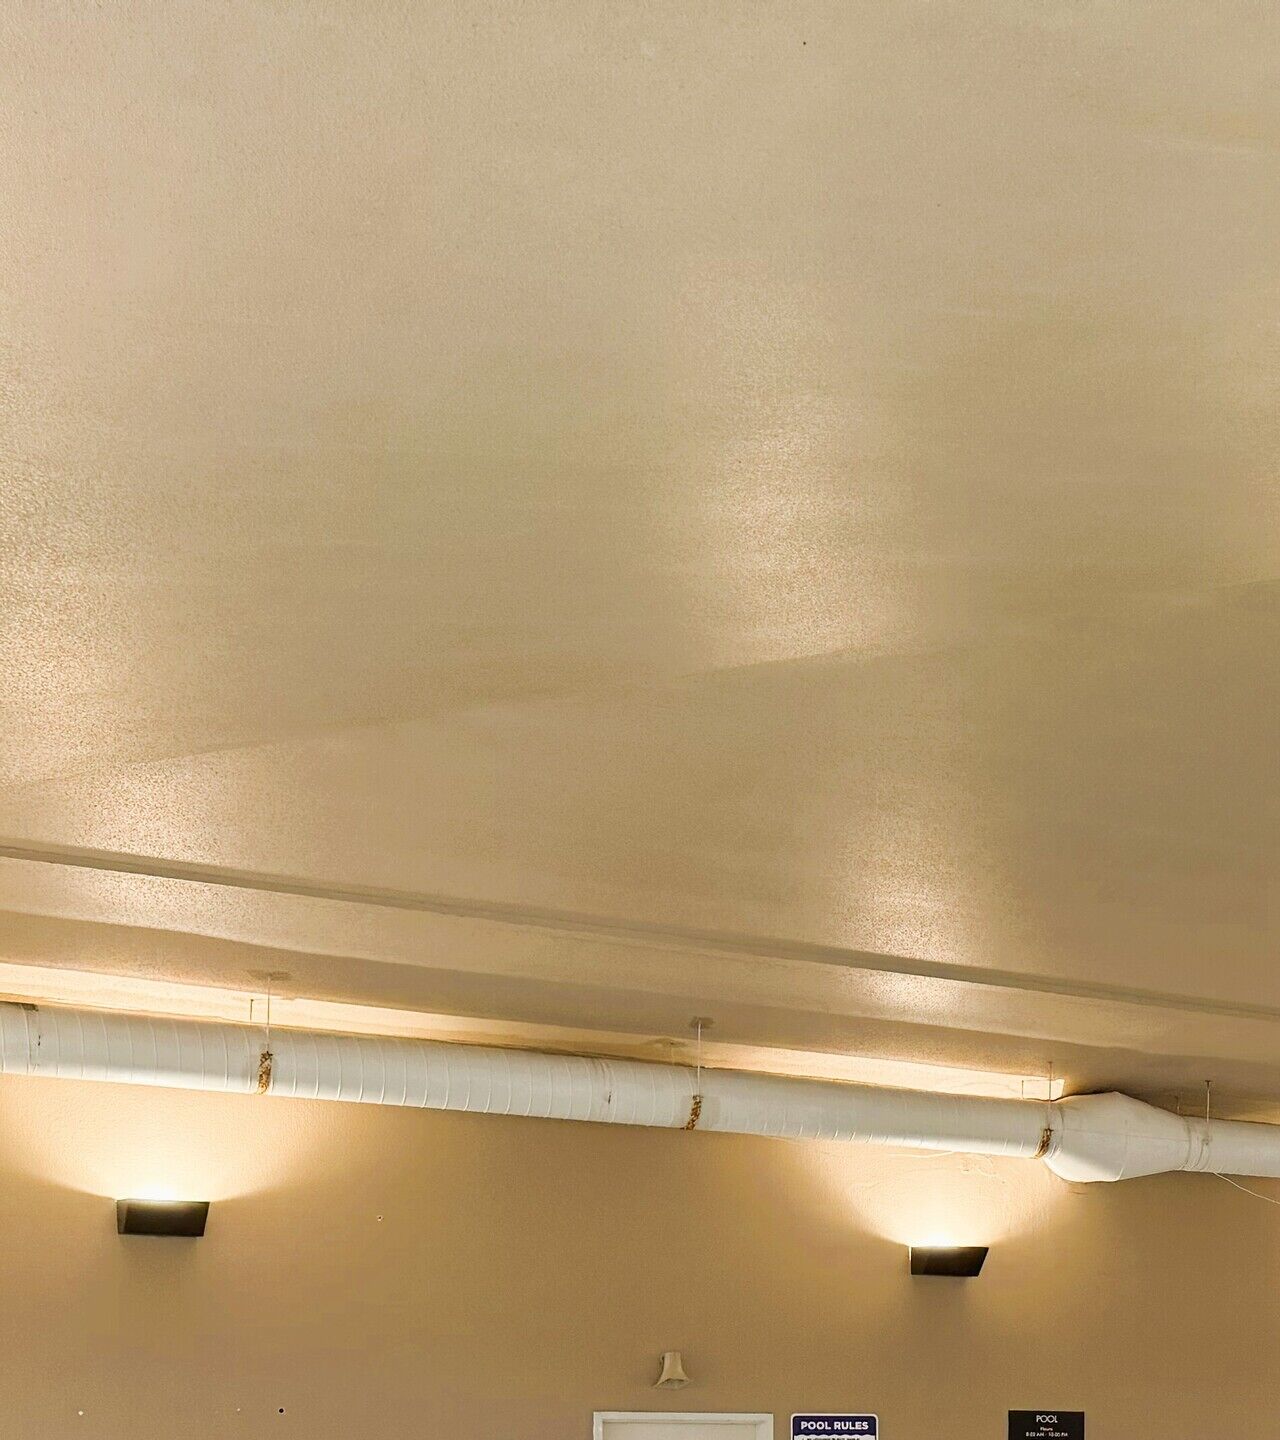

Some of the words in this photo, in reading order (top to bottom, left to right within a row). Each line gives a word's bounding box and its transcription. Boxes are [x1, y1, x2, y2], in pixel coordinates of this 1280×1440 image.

[1036, 1415, 1058, 1423] POOL
[800, 1421, 831, 1430] POOL
[834, 1421, 869, 1430] RULES
